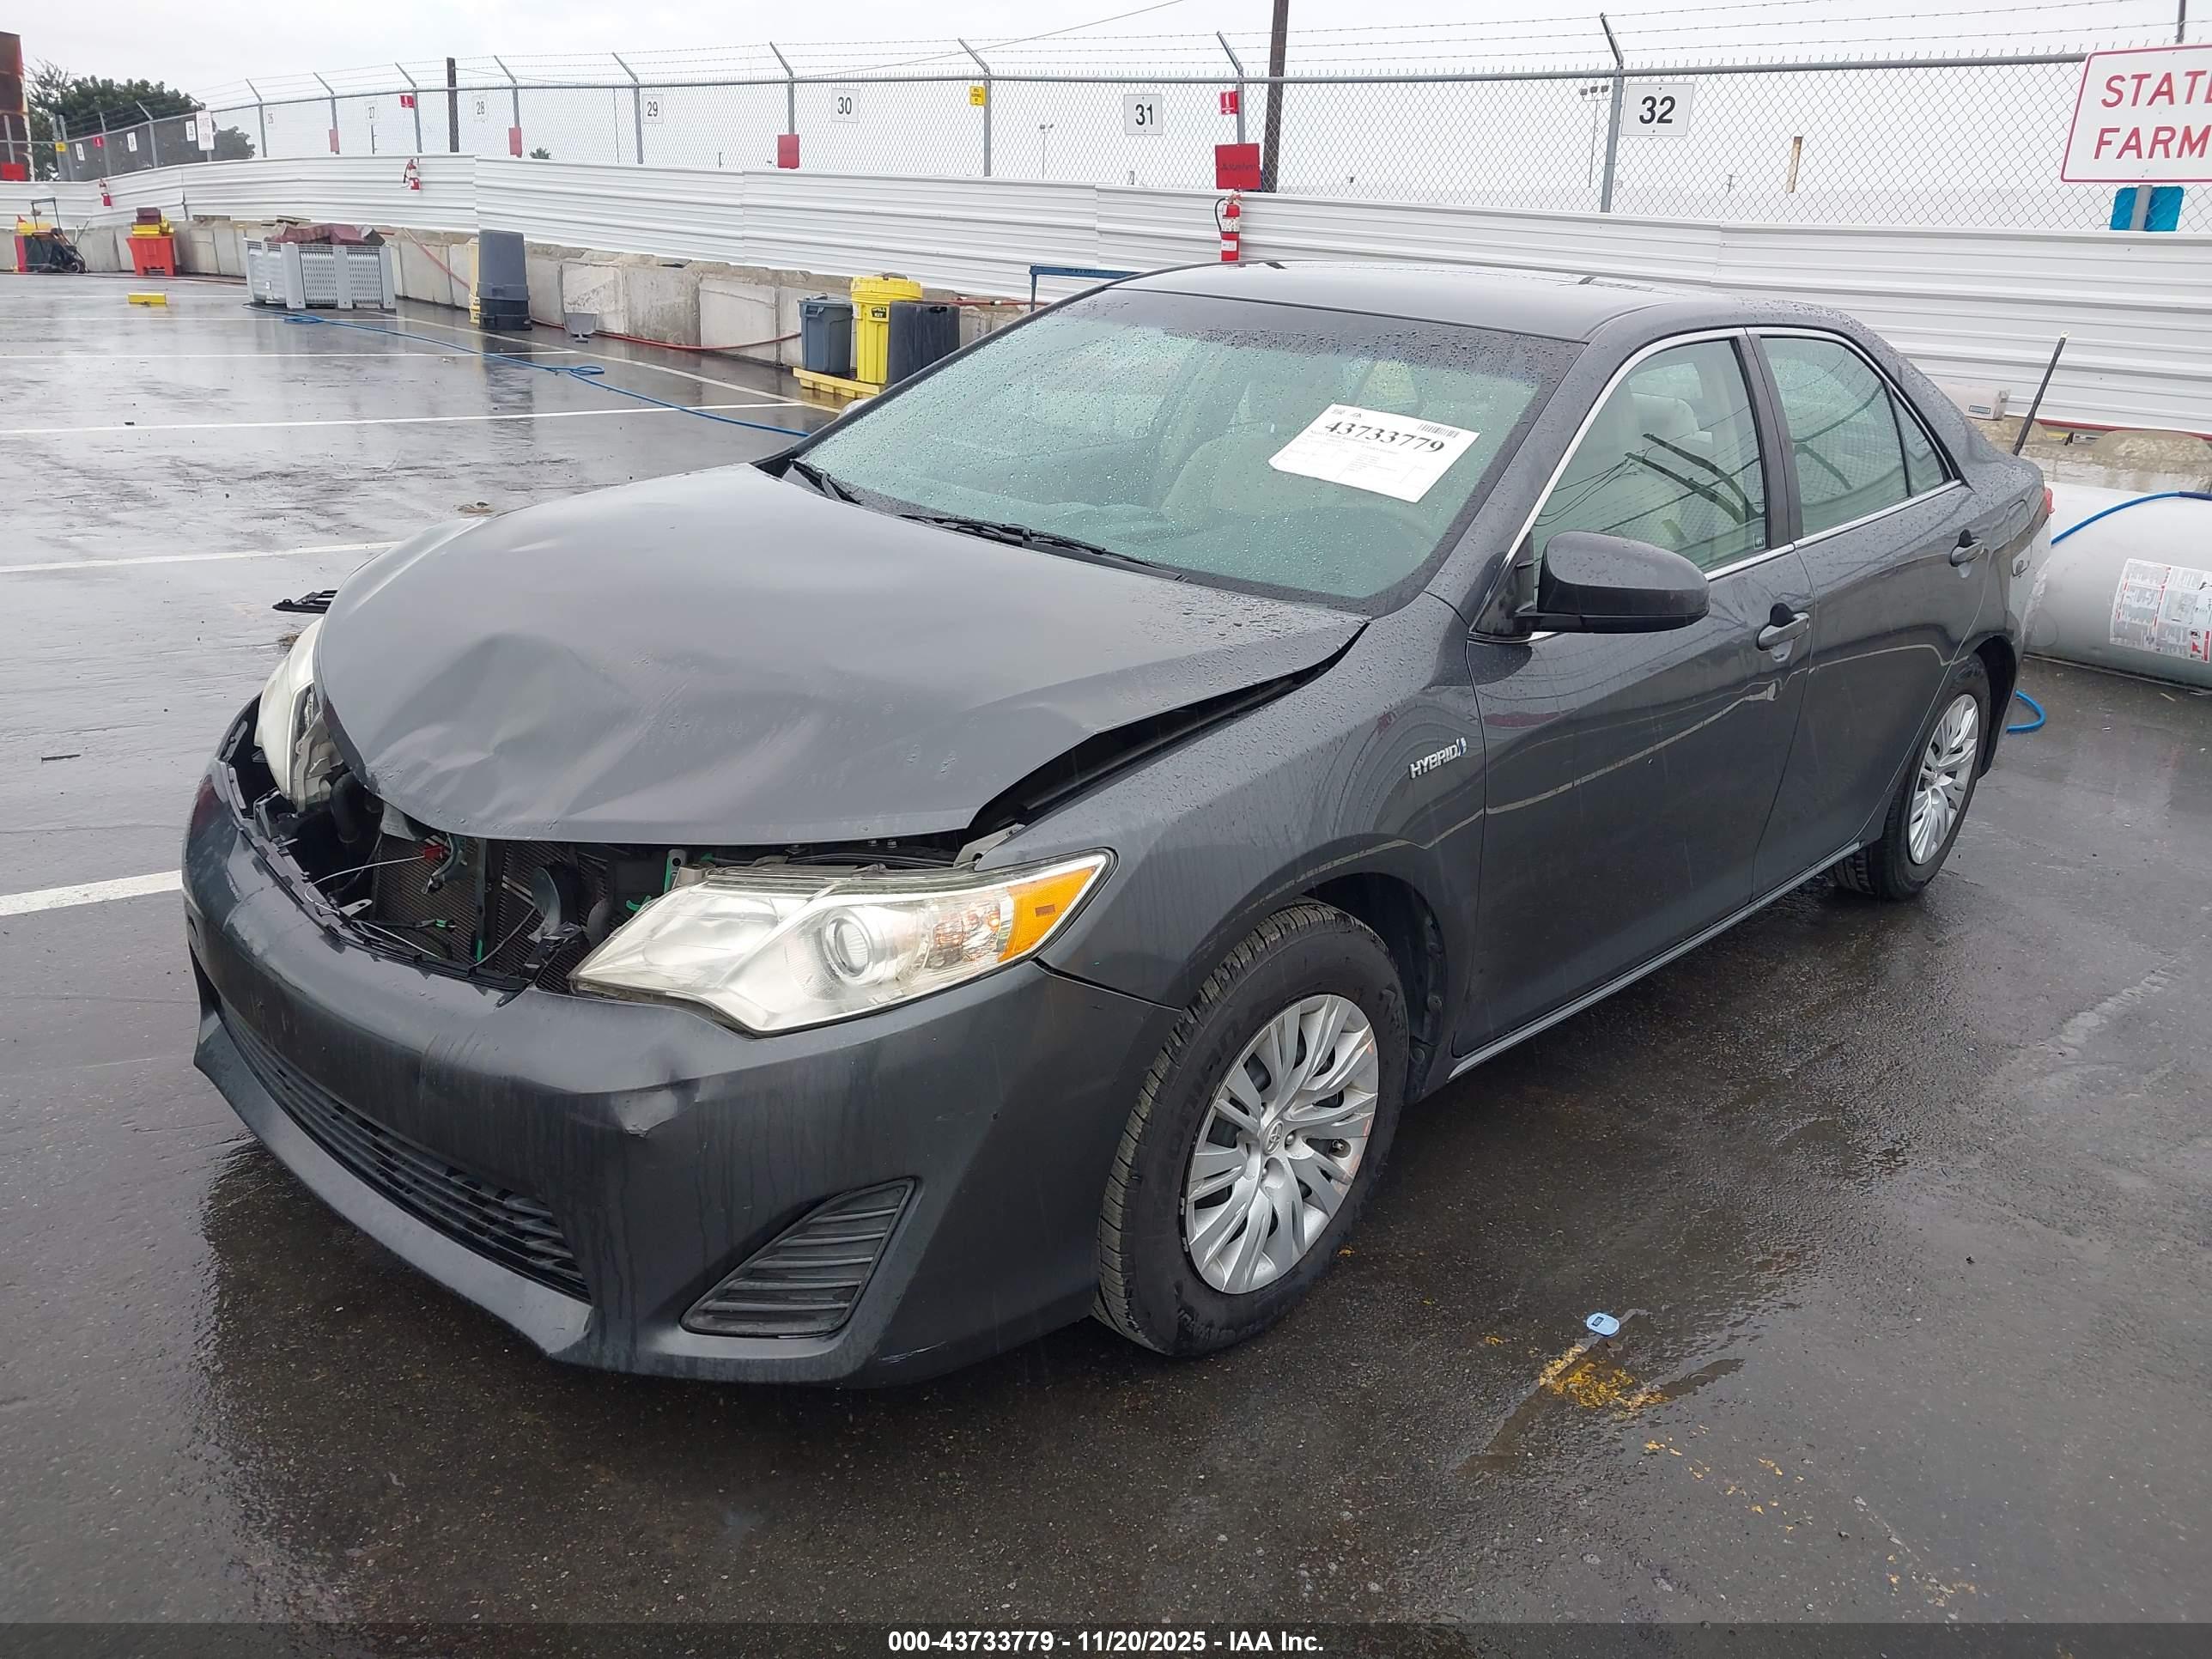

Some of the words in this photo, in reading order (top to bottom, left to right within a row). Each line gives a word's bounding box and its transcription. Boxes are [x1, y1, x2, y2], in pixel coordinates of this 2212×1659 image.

[368, 106, 375, 118] 27
[476, 100, 485, 115] 28
[647, 100, 659, 117] 29
[837, 96, 852, 115] 30
[1135, 103, 1153, 126] 31
[1638, 95, 1676, 125] 32
[2094, 125, 2212, 160] FARM
[1325, 421, 1445, 453] 43733779
[1409, 744, 1459, 779] HYBRID
